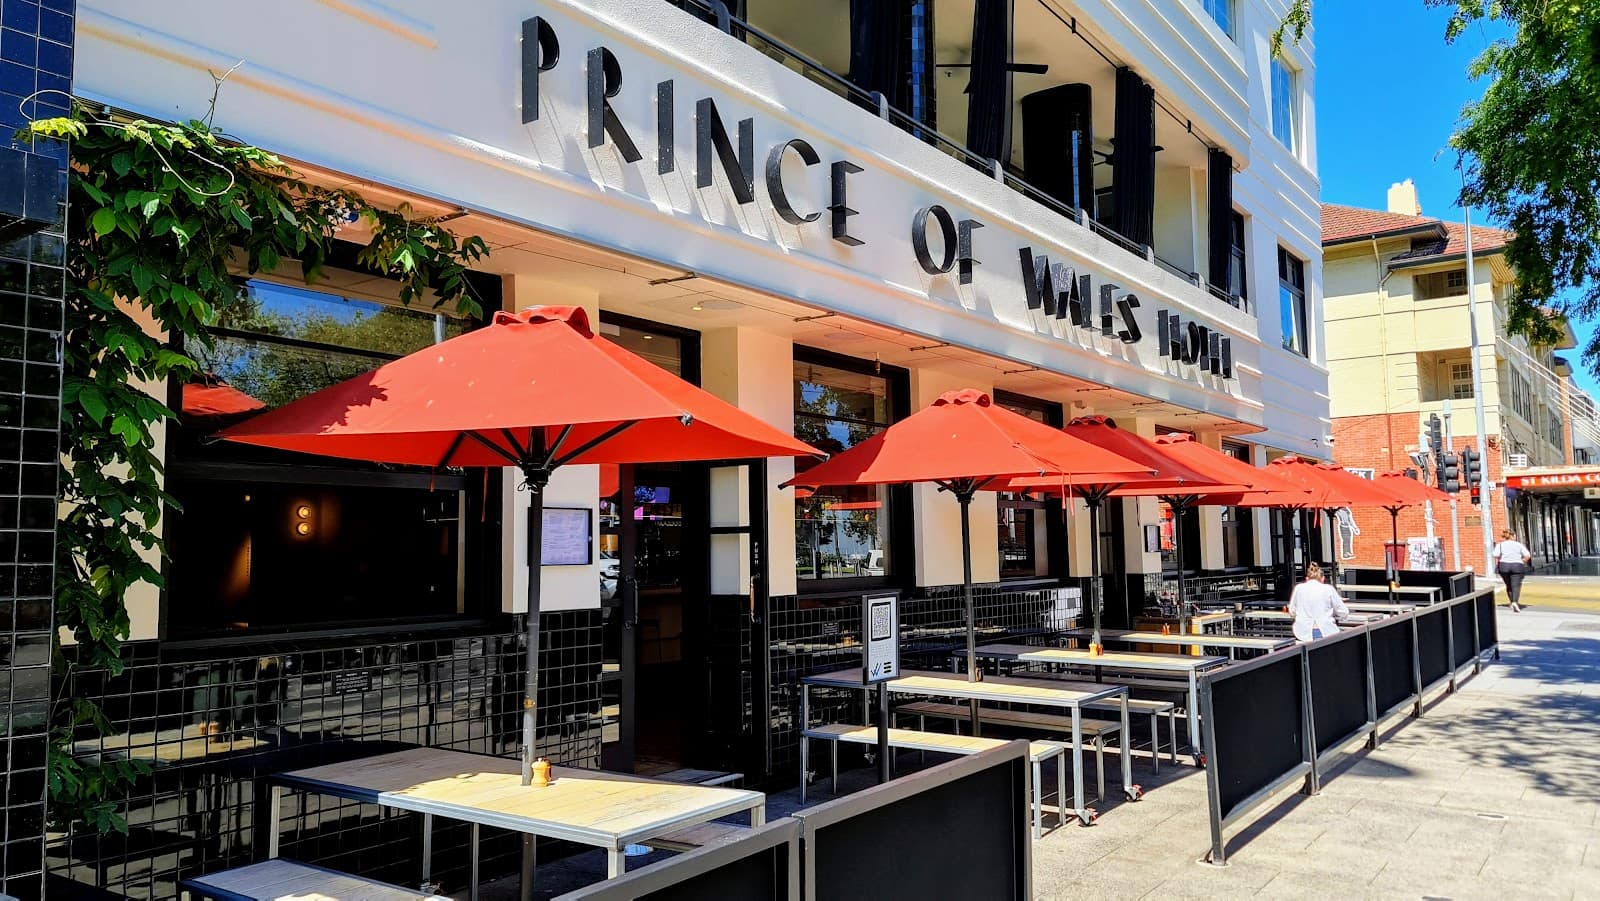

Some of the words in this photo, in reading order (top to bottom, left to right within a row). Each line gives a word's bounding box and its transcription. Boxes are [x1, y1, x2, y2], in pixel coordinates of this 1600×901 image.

[522, 16, 865, 246] PRINCE
[912, 205, 984, 285] OF
[1018, 246, 1142, 344] WALES
[1541, 474, 1582, 485] KILDA
